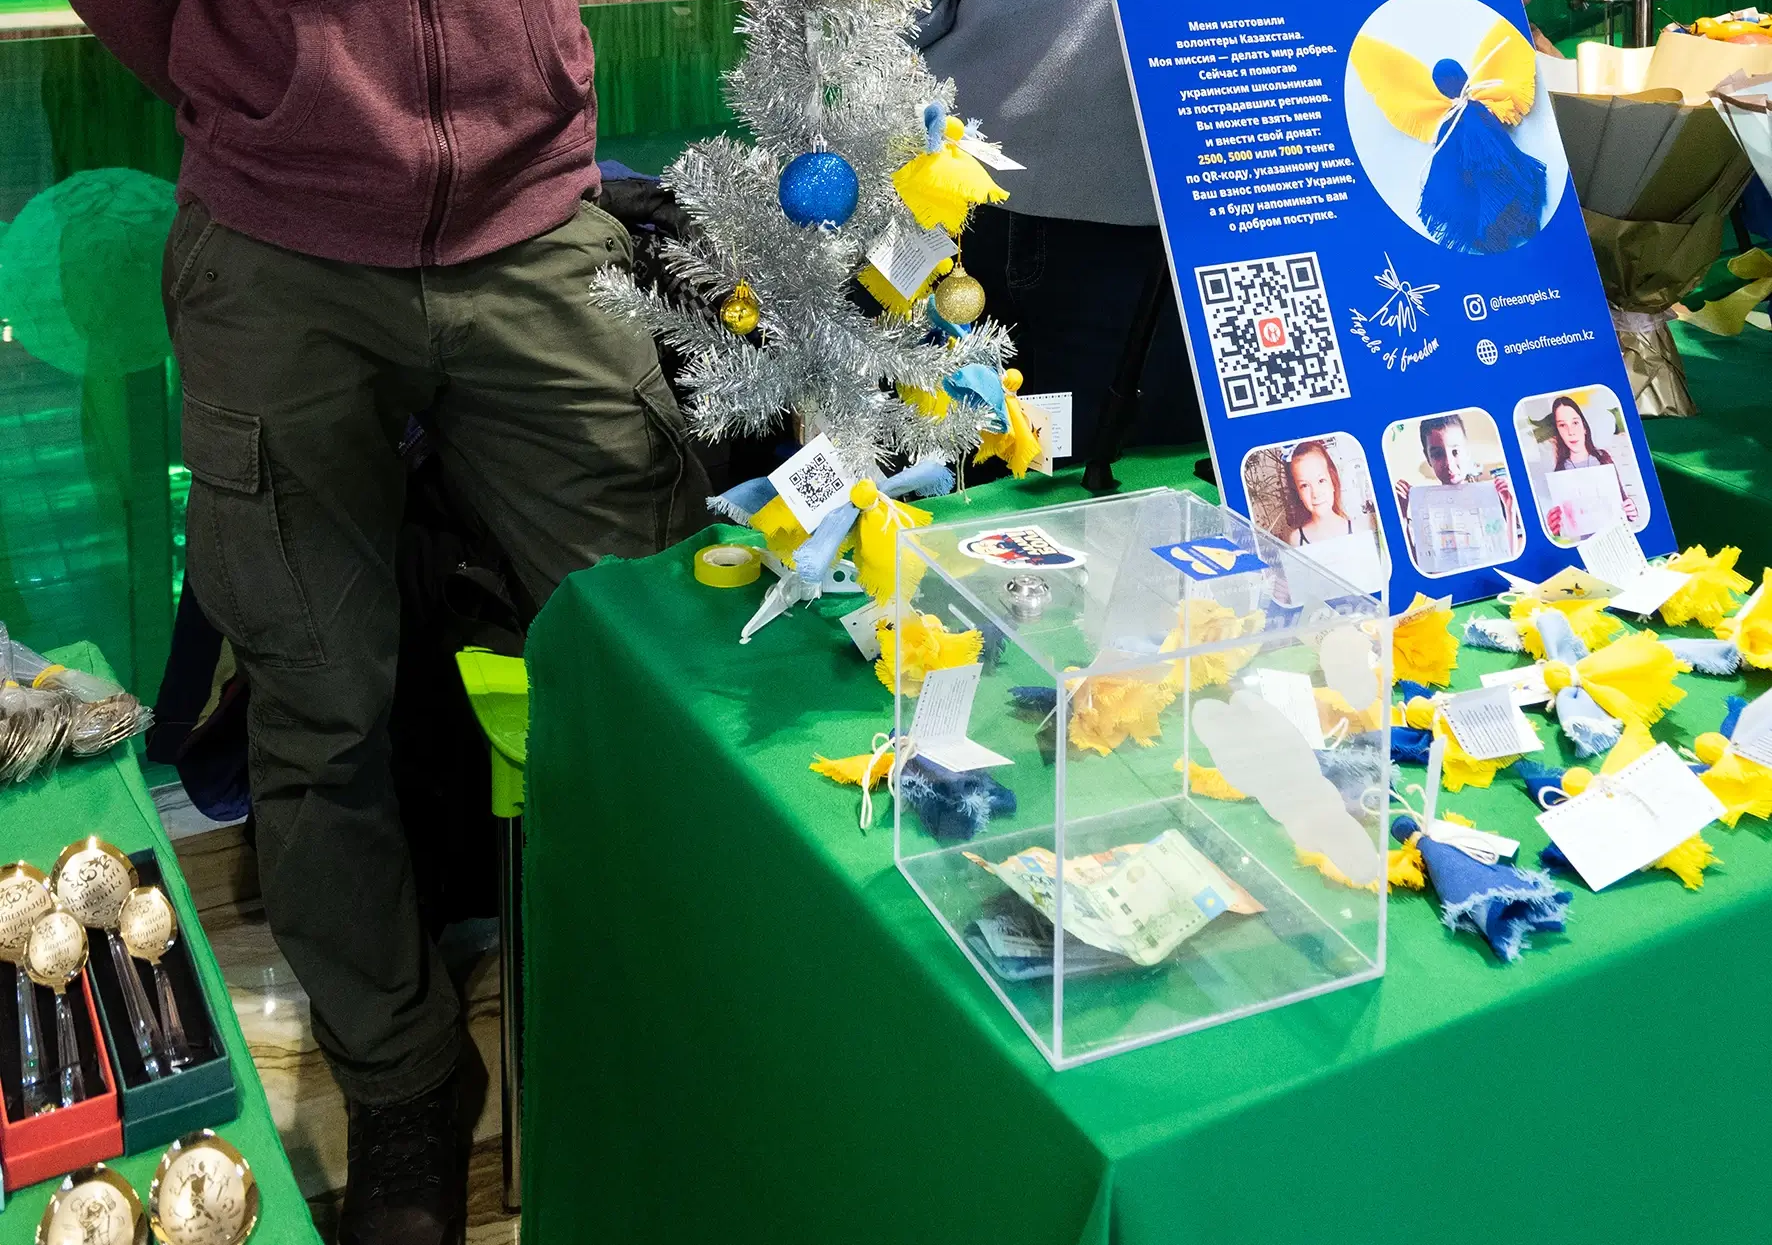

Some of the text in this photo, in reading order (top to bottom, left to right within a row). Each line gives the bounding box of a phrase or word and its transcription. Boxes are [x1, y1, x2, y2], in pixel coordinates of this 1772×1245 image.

[1188, 15, 1285, 32] Меня изготовили
[1176, 30, 1305, 49] волонтеры Казахстана.
[1148, 57, 1173, 68] Моя
[1174, 54, 1216, 66] миссия
[1230, 50, 1270, 64] делать
[1271, 47, 1295, 60] мир
[1295, 43, 1337, 57] добрее.
[1198, 63, 1297, 81] Сейчас я помогаю
[1179, 77, 1323, 102] украинским школьникам
[1178, 93, 1333, 116] из пострадавших регионов.
[1196, 110, 1322, 132] Вы можете взять меня
[1205, 126, 1322, 148] и внести свой донат:
[1198, 142, 1336, 166] 2500, 5000 или 7000 тенге
[1186, 157, 1355, 185] по QR-коду, указанному ниже.
[1192, 174, 1356, 201] Ваш взнос поможет Украине,
[1209, 190, 1348, 217] а я буду напоминать вам
[1229, 210, 1338, 233] о добром поступке.
[1489, 287, 1561, 312] @freeangels.kz
[1349, 307, 1440, 372] Angels of freedom
[1503, 329, 1595, 356] angelsoffreedom.kz
